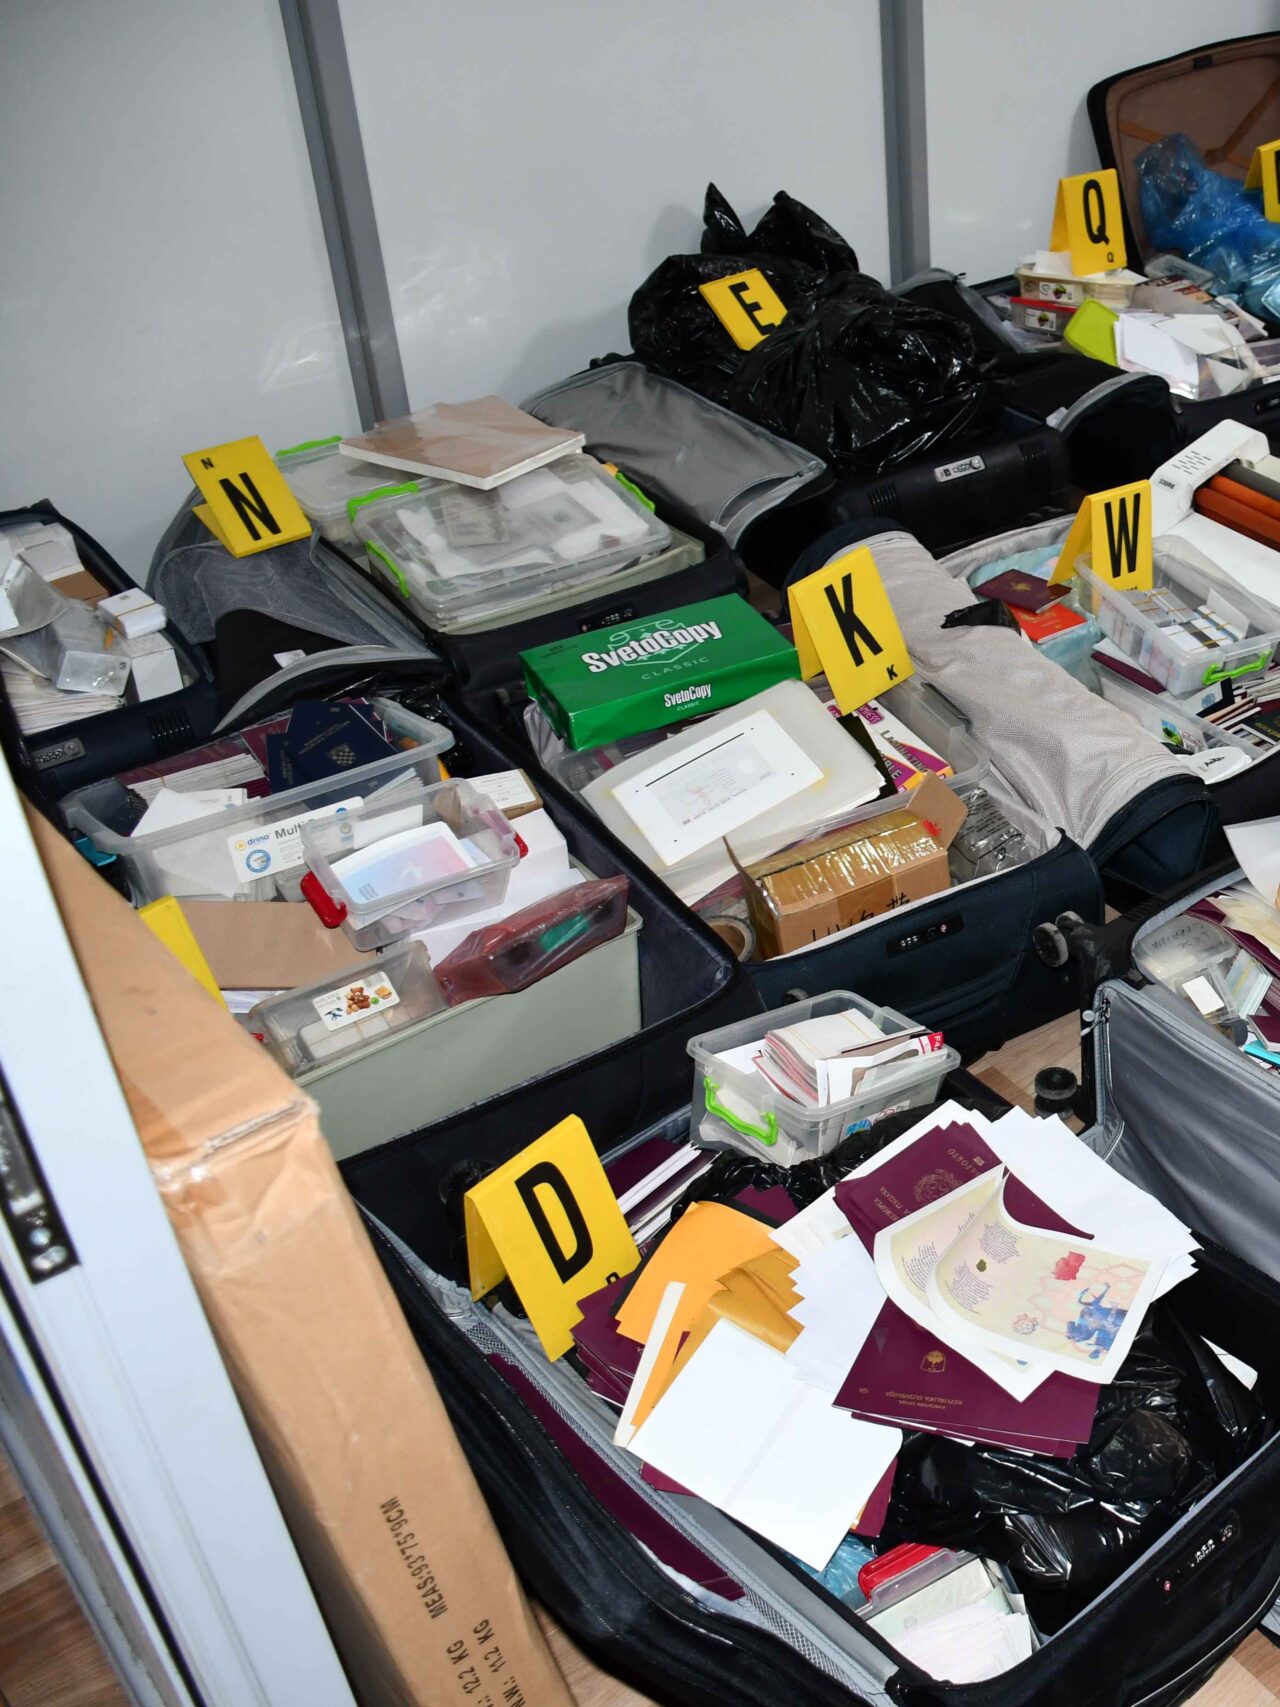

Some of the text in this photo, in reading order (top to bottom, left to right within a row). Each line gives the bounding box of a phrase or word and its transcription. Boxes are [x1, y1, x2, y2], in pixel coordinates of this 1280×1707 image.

[1083, 178, 1110, 246] Q
[1106, 252, 1114, 264] Q
[727, 281, 777, 337] E
[200, 457, 215, 470] N
[218, 472, 282, 542] N
[1103, 492, 1141, 579] W
[823, 572, 884, 668] K
[581, 619, 723, 674] SvetoCopy
[641, 656, 710, 681] CLASSIC
[886, 664, 899, 682] K
[663, 683, 712, 709] SvetoCopy
[274, 819, 306, 840] Mult
[514, 1161, 594, 1285] D
[472, 1618, 495, 1646] KG
[445, 1639, 482, 1694] 12.2 KG
[483, 1646, 507, 1674] 11.2
